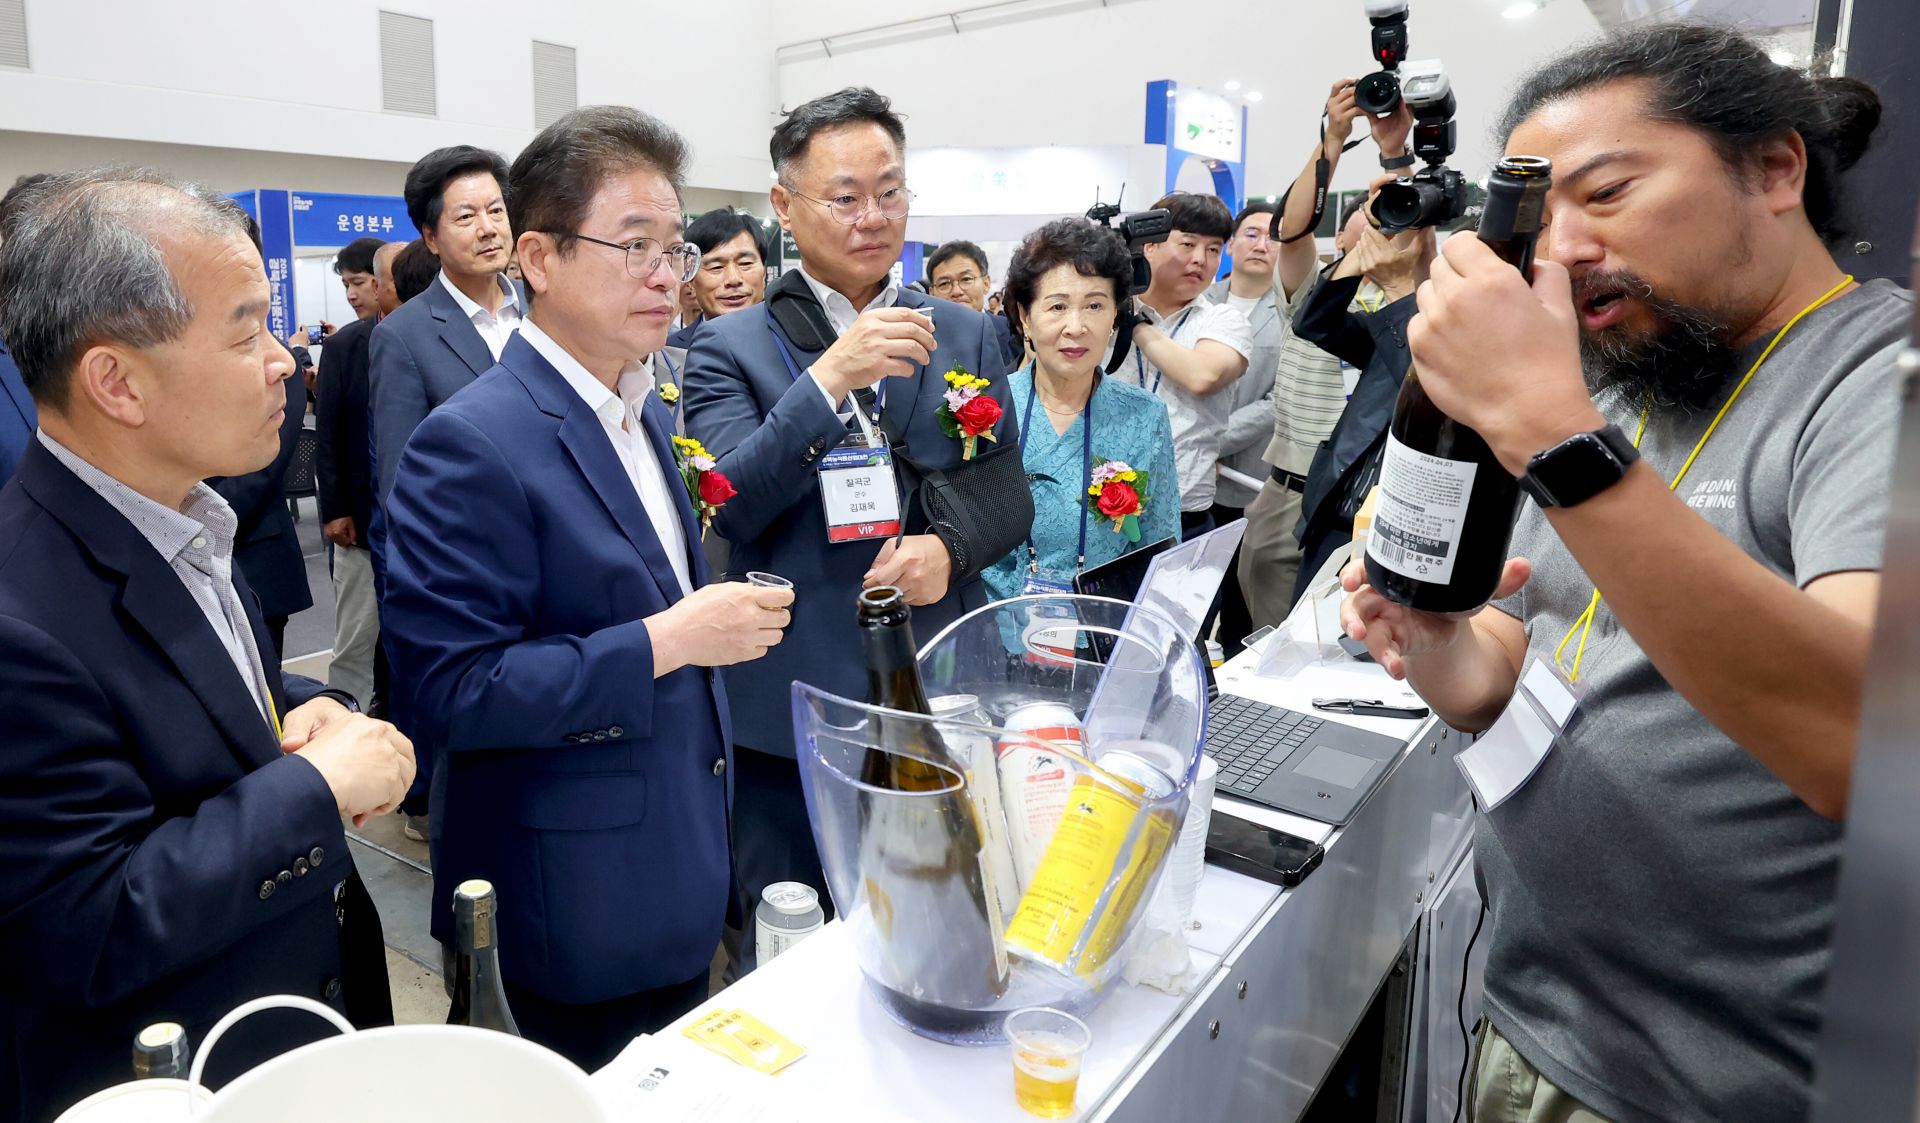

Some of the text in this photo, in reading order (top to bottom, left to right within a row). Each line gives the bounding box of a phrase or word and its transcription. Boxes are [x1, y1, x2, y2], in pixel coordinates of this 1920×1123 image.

[1315, 187, 1324, 214] Canon
[337, 214, 394, 233] 운영본부
[846, 477, 871, 488] 칠곡군
[858, 525, 875, 535] VIP
[1402, 531, 1440, 548] 청소년에게
[1402, 540, 1417, 551] 금지
